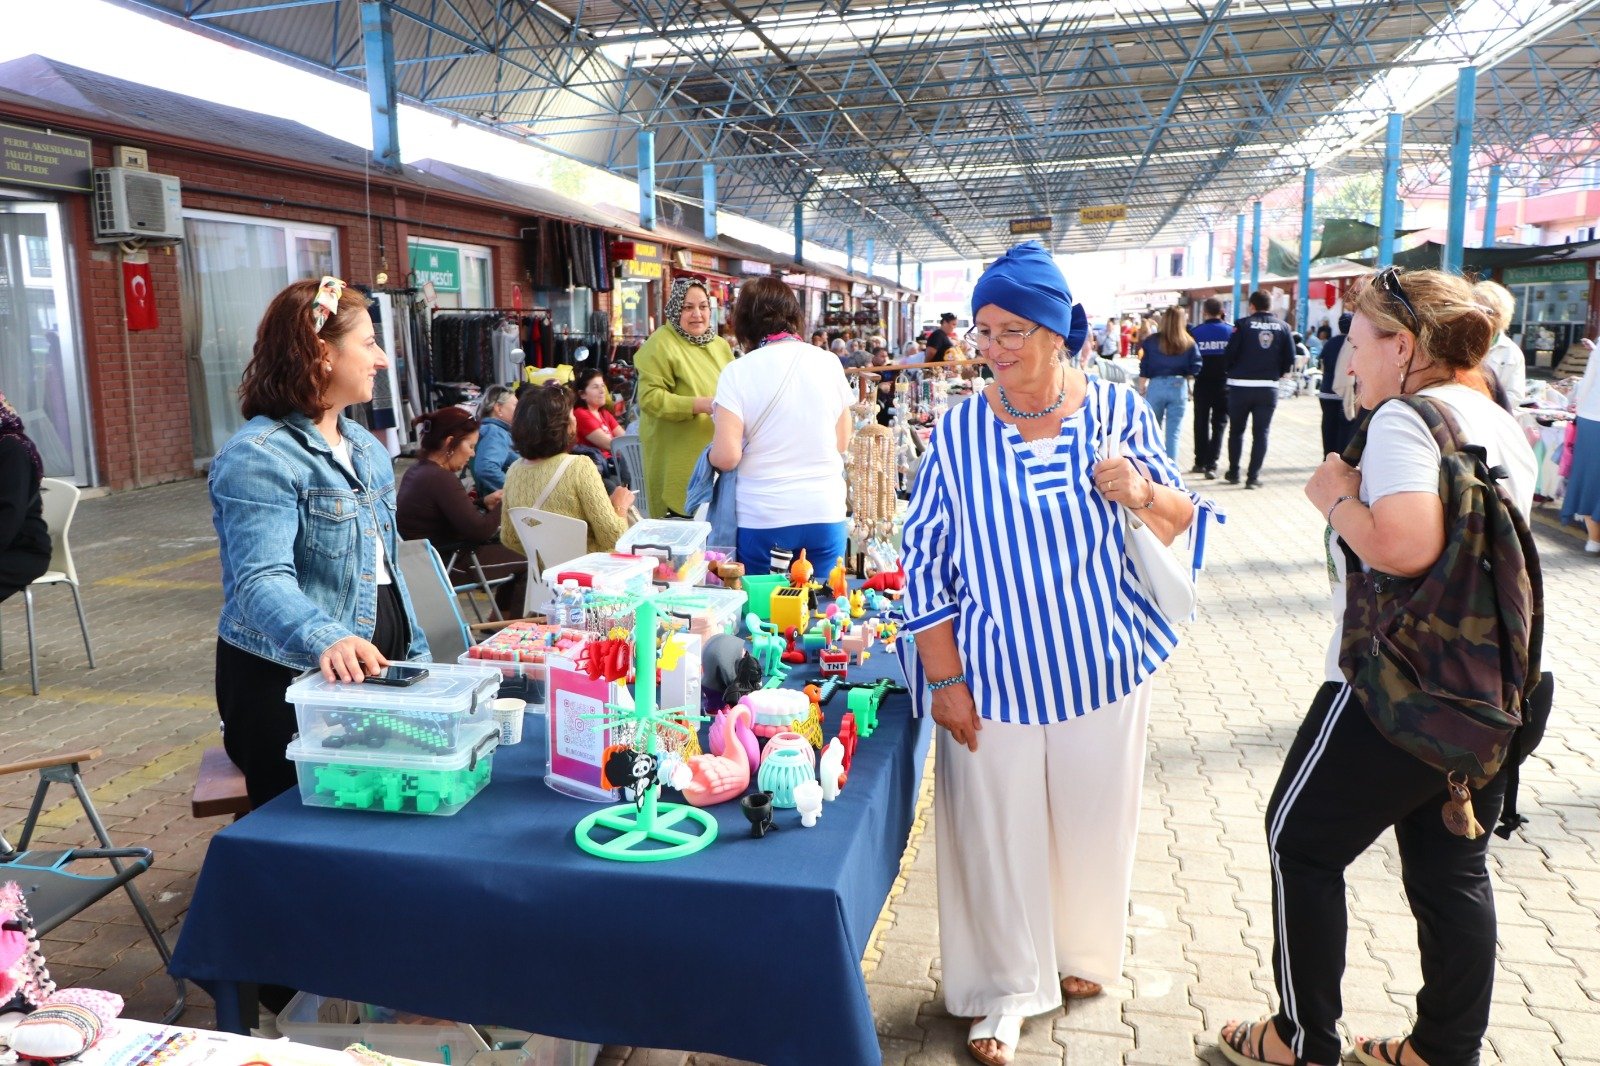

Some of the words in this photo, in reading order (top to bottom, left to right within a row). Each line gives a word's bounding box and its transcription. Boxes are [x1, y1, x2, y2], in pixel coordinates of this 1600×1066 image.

[3, 137, 29, 149] PERDE
[34, 154, 60, 165] PERDE
[24, 164, 49, 175] PERDE
[415, 269, 429, 284] BAY
[1542, 264, 1585, 279] Kebap
[1250, 321, 1281, 331] ZABITA
